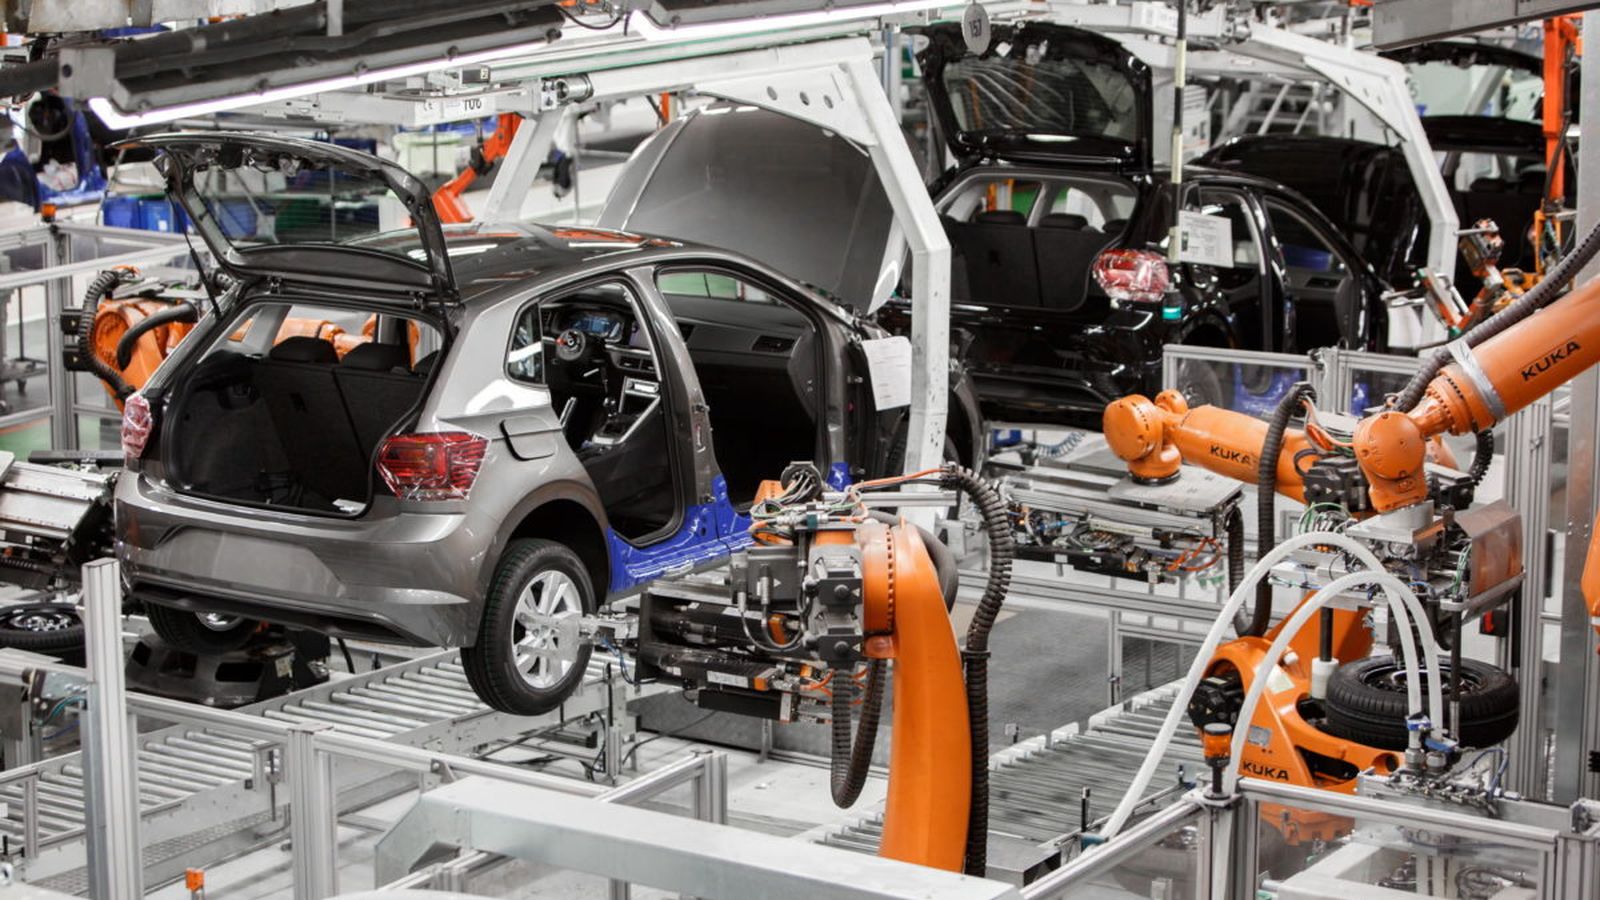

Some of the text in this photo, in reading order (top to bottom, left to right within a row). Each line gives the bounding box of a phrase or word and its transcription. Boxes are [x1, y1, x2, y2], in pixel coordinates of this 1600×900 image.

[1521, 341, 1580, 381] KUKA
[1210, 445, 1251, 464] KUKA
[1243, 761, 1289, 781] KUKA
